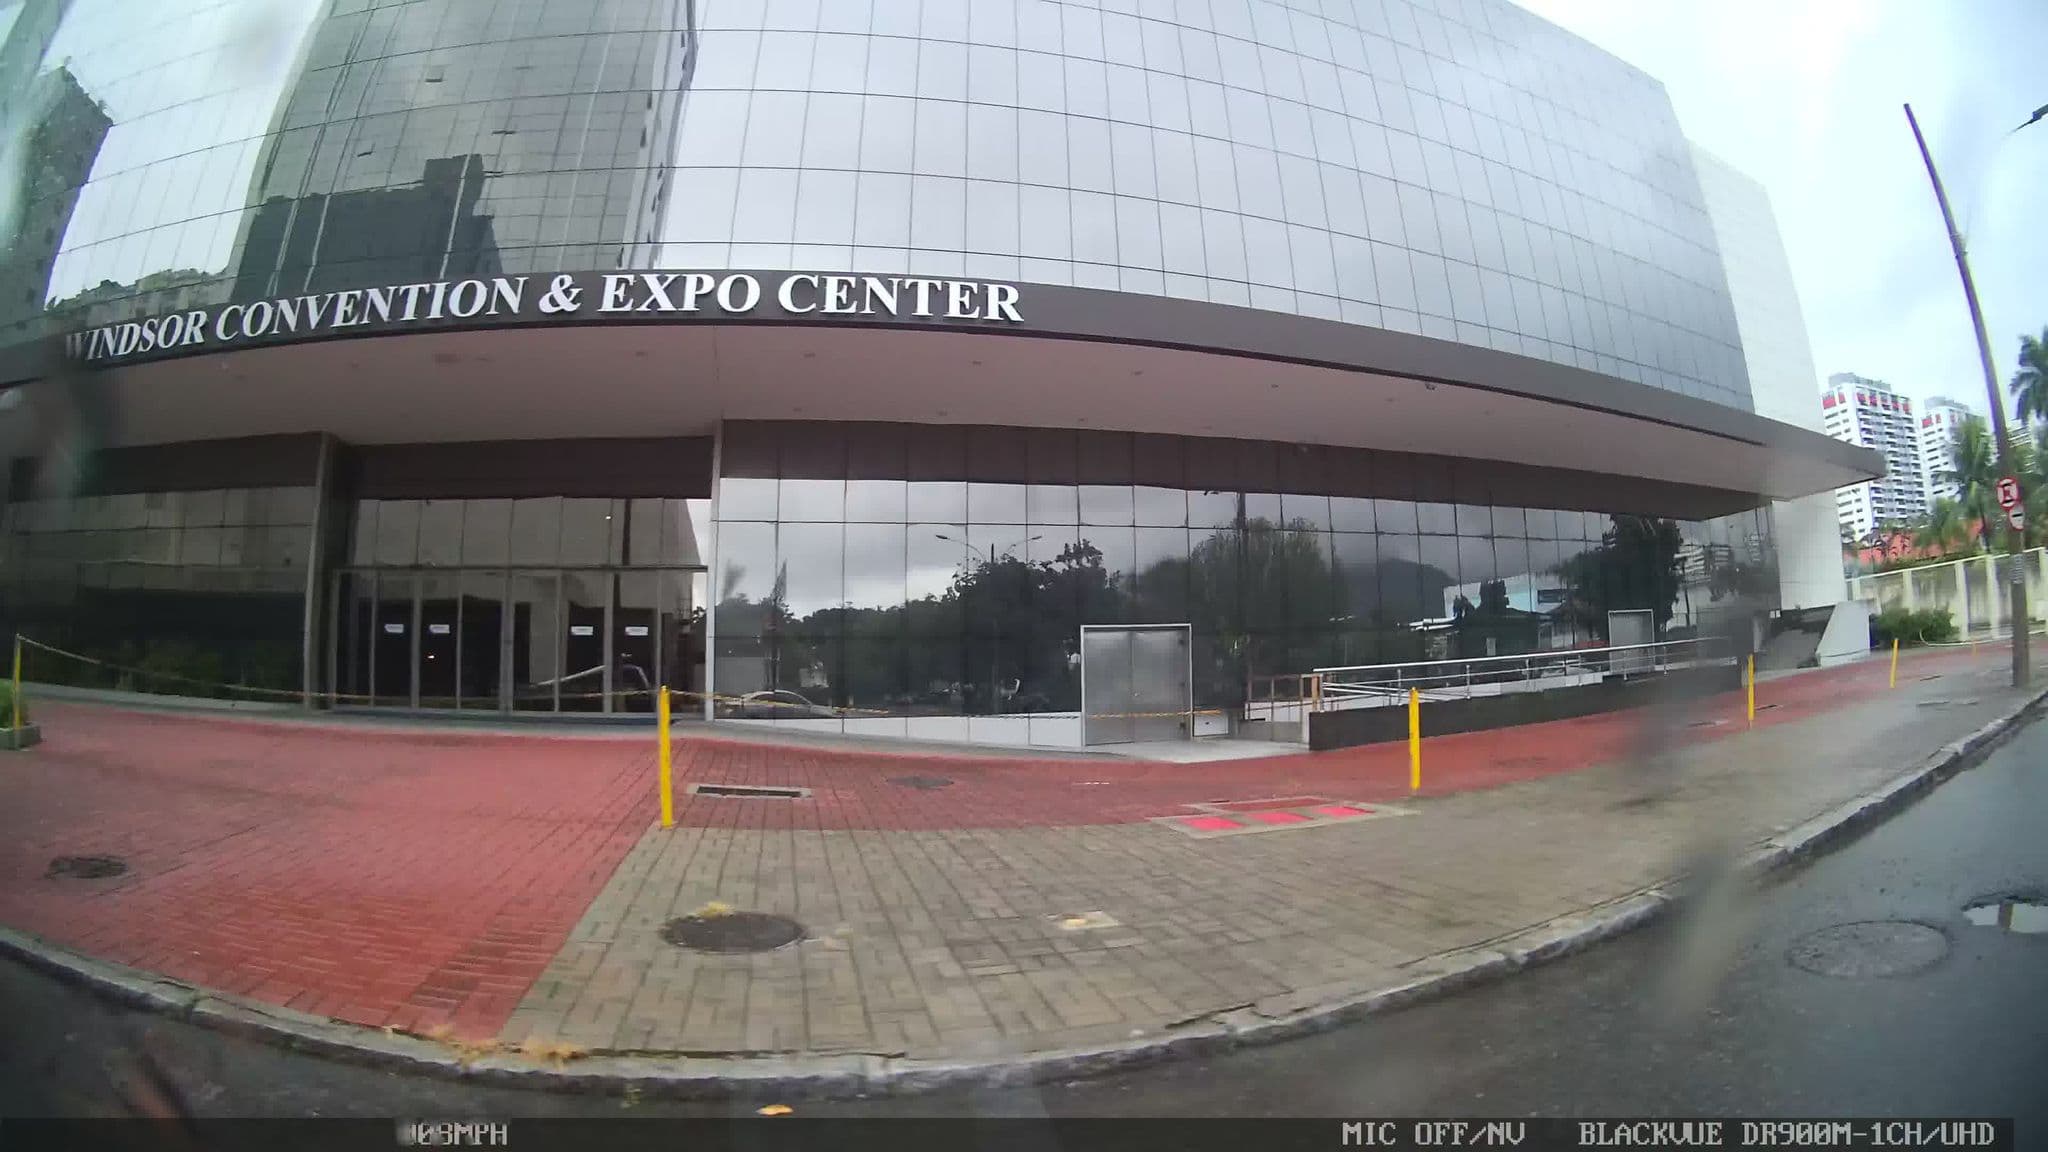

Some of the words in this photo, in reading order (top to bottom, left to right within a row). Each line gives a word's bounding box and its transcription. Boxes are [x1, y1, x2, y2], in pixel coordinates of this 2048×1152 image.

[65, 310, 207, 360] WINDSOR
[215, 276, 528, 341] CONVENTION
[538, 273, 582, 315] &
[597, 273, 761, 314] EXPO
[777, 274, 1025, 323] CENTER
